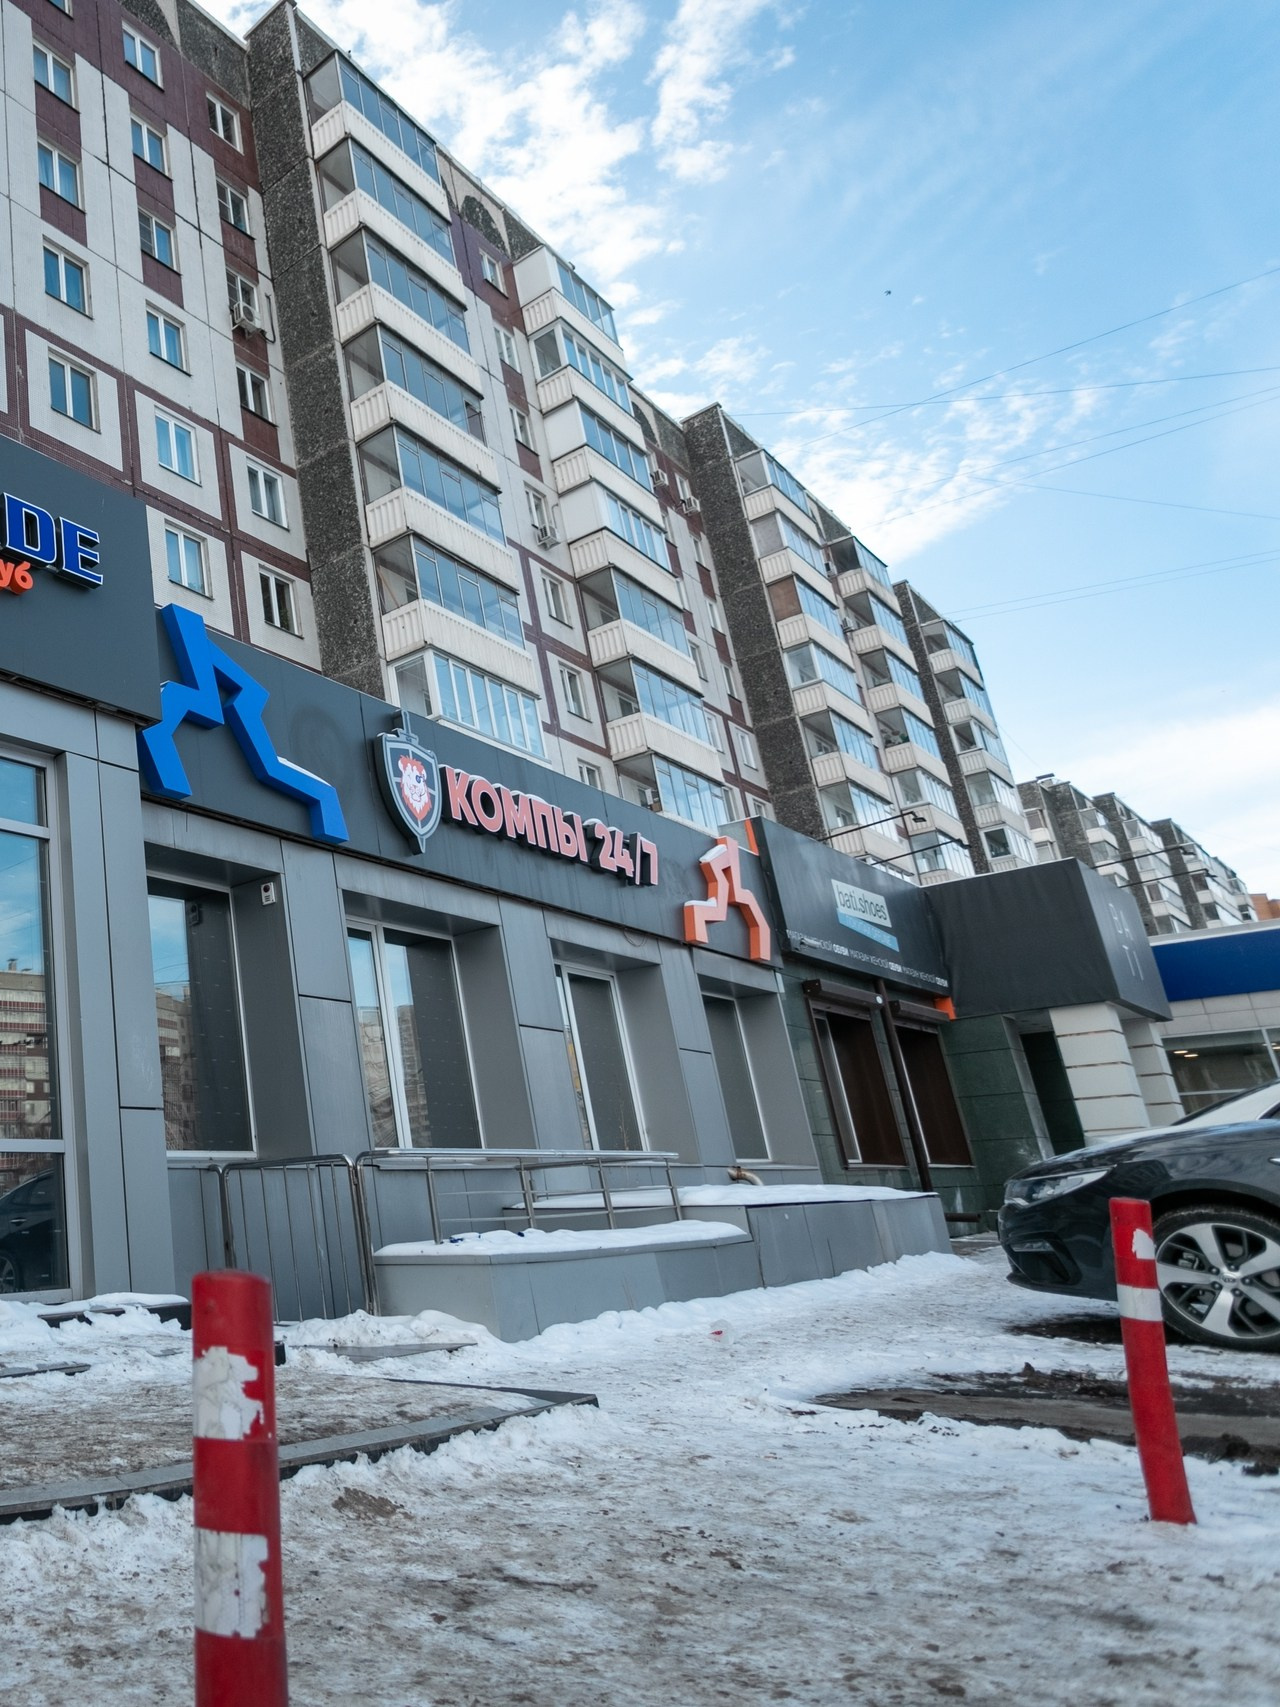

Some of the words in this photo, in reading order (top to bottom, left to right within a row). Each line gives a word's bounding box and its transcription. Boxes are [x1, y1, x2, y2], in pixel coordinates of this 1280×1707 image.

[443, 764, 588, 863] КОМПЫ
[591, 826, 659, 886] 24/7
[835, 884, 887, 921] bati.shoes
